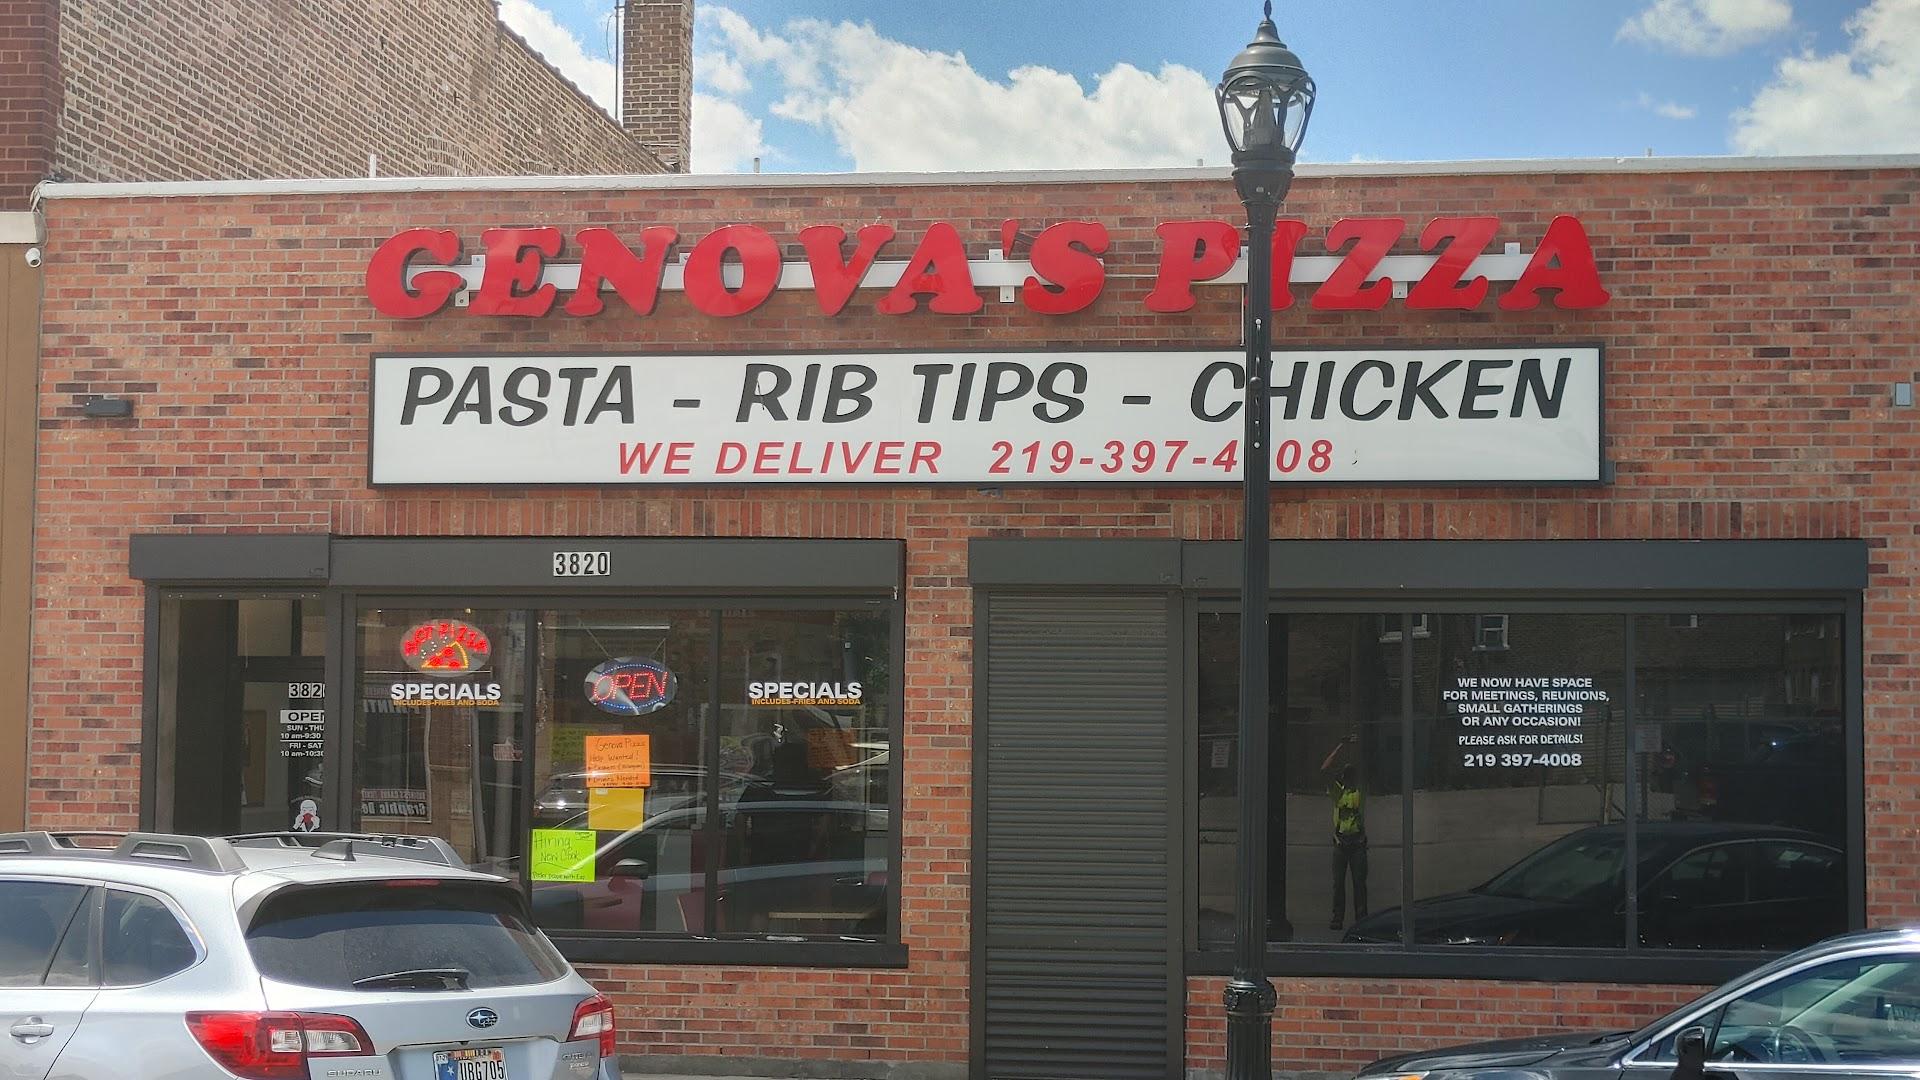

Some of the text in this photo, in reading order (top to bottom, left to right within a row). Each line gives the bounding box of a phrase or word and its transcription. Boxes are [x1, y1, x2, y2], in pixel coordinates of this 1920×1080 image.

[366, 215, 1610, 319] GENOVA'S PIZZA
[400, 358, 1571, 426] PASTA - RIB TIPS - CHICKEN
[618, 439, 1333, 475] WE DELIVER 219-397-408
[555, 553, 608, 575] 3820
[404, 622, 488, 656] HOT PIZZA
[290, 684, 325, 697] 382
[391, 683, 501, 700] SPECIALS
[592, 671, 668, 700] OPEN
[748, 682, 862, 699] SPECIALS
[1457, 678, 1592, 688] WE NOW HAVE SPACE
[1443, 691, 1609, 702] FOR MEETINGS, REUNIONS,
[1458, 703, 1583, 713] SMALL GATHERINGS
[1462, 717, 1581, 726] OR ANY OCCASION!
[1458, 734, 1583, 745] PLEASE ASK FOR DETAILS!
[1464, 753, 1582, 767] 219 397-4008
[534, 832, 572, 850] Hiring
[327, 1069, 381, 1077] SUBARU
